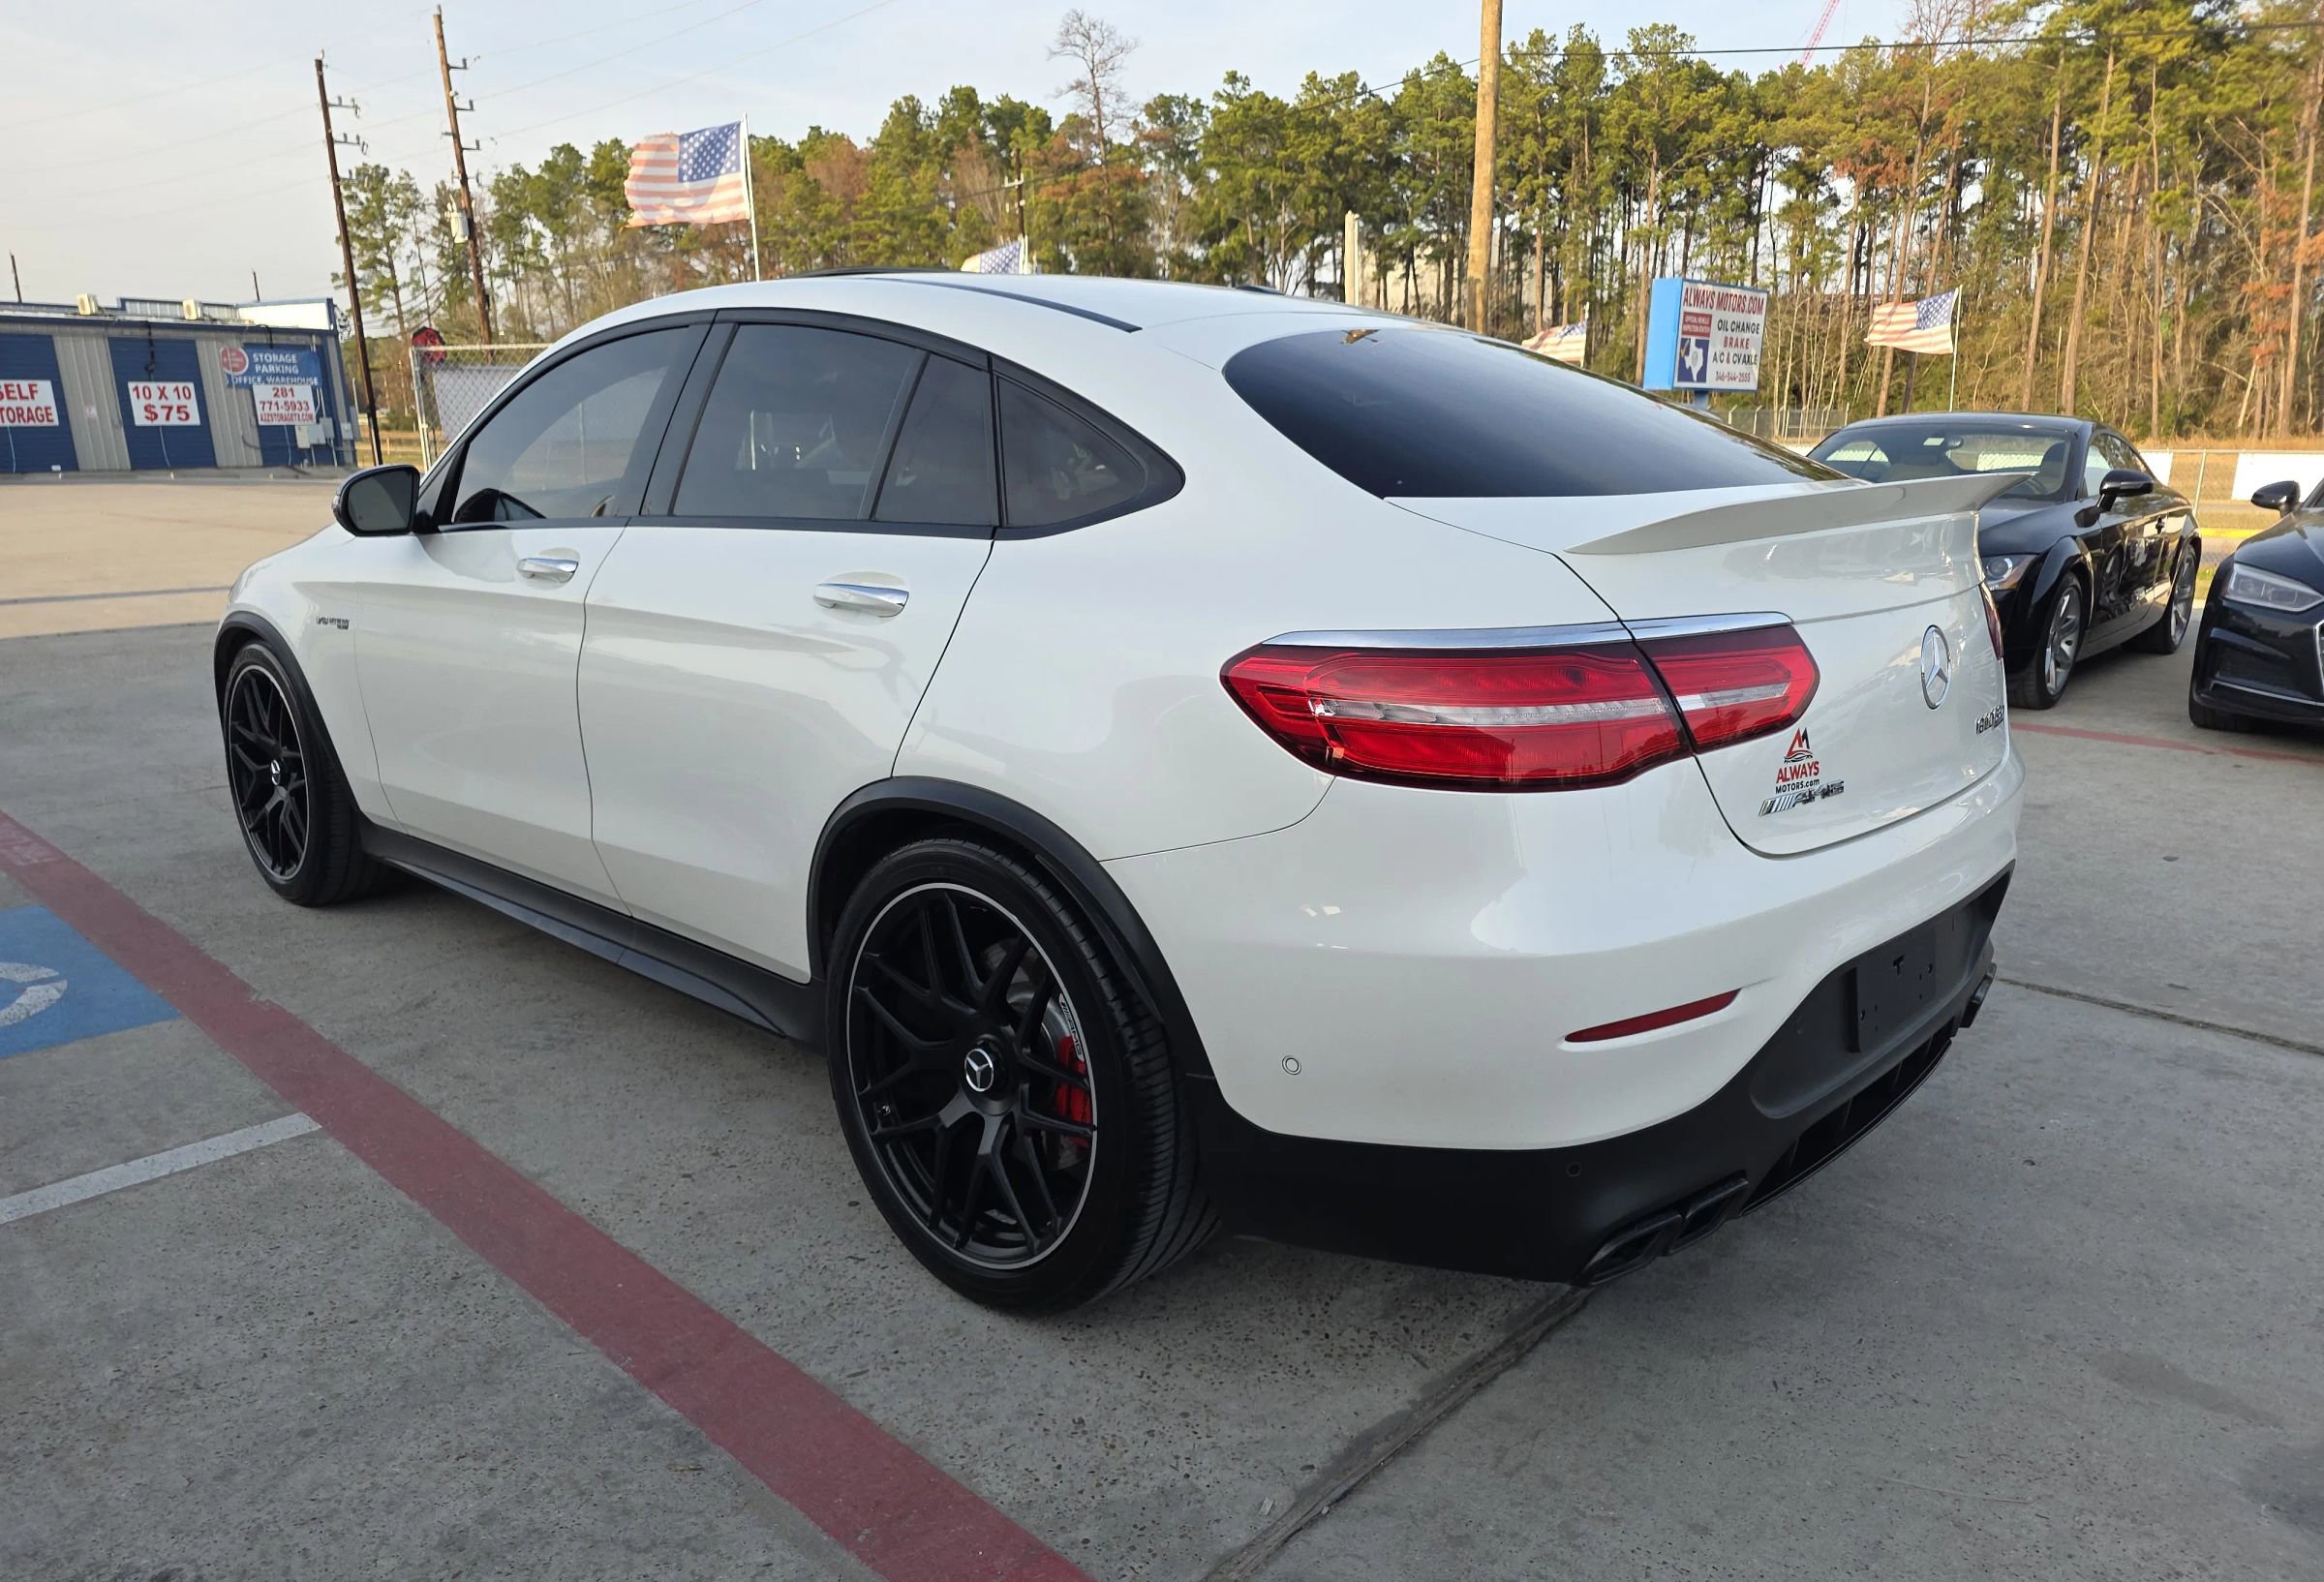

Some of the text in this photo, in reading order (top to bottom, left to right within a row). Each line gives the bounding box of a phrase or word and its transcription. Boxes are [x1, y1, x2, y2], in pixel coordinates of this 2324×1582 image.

[1683, 288, 1763, 315] ALWAYS MOTORS.COM
[1717, 319, 1728, 332] OIL
[1730, 319, 1760, 334] CHANGE
[1724, 336, 1750, 350] BRAKE
[253, 352, 297, 364] STORAGE
[255, 363, 299, 375] PARKING
[266, 376, 319, 386] WAREHOUSE
[133, 384, 152, 401] 10
[173, 385, 192, 401] 10
[272, 386, 295, 398] 281
[143, 403, 191, 423] $75
[259, 400, 310, 412] 771-5933
[1776, 761, 1819, 783] ALWAYS
[1776, 778, 1819, 794] MOTORS.com
